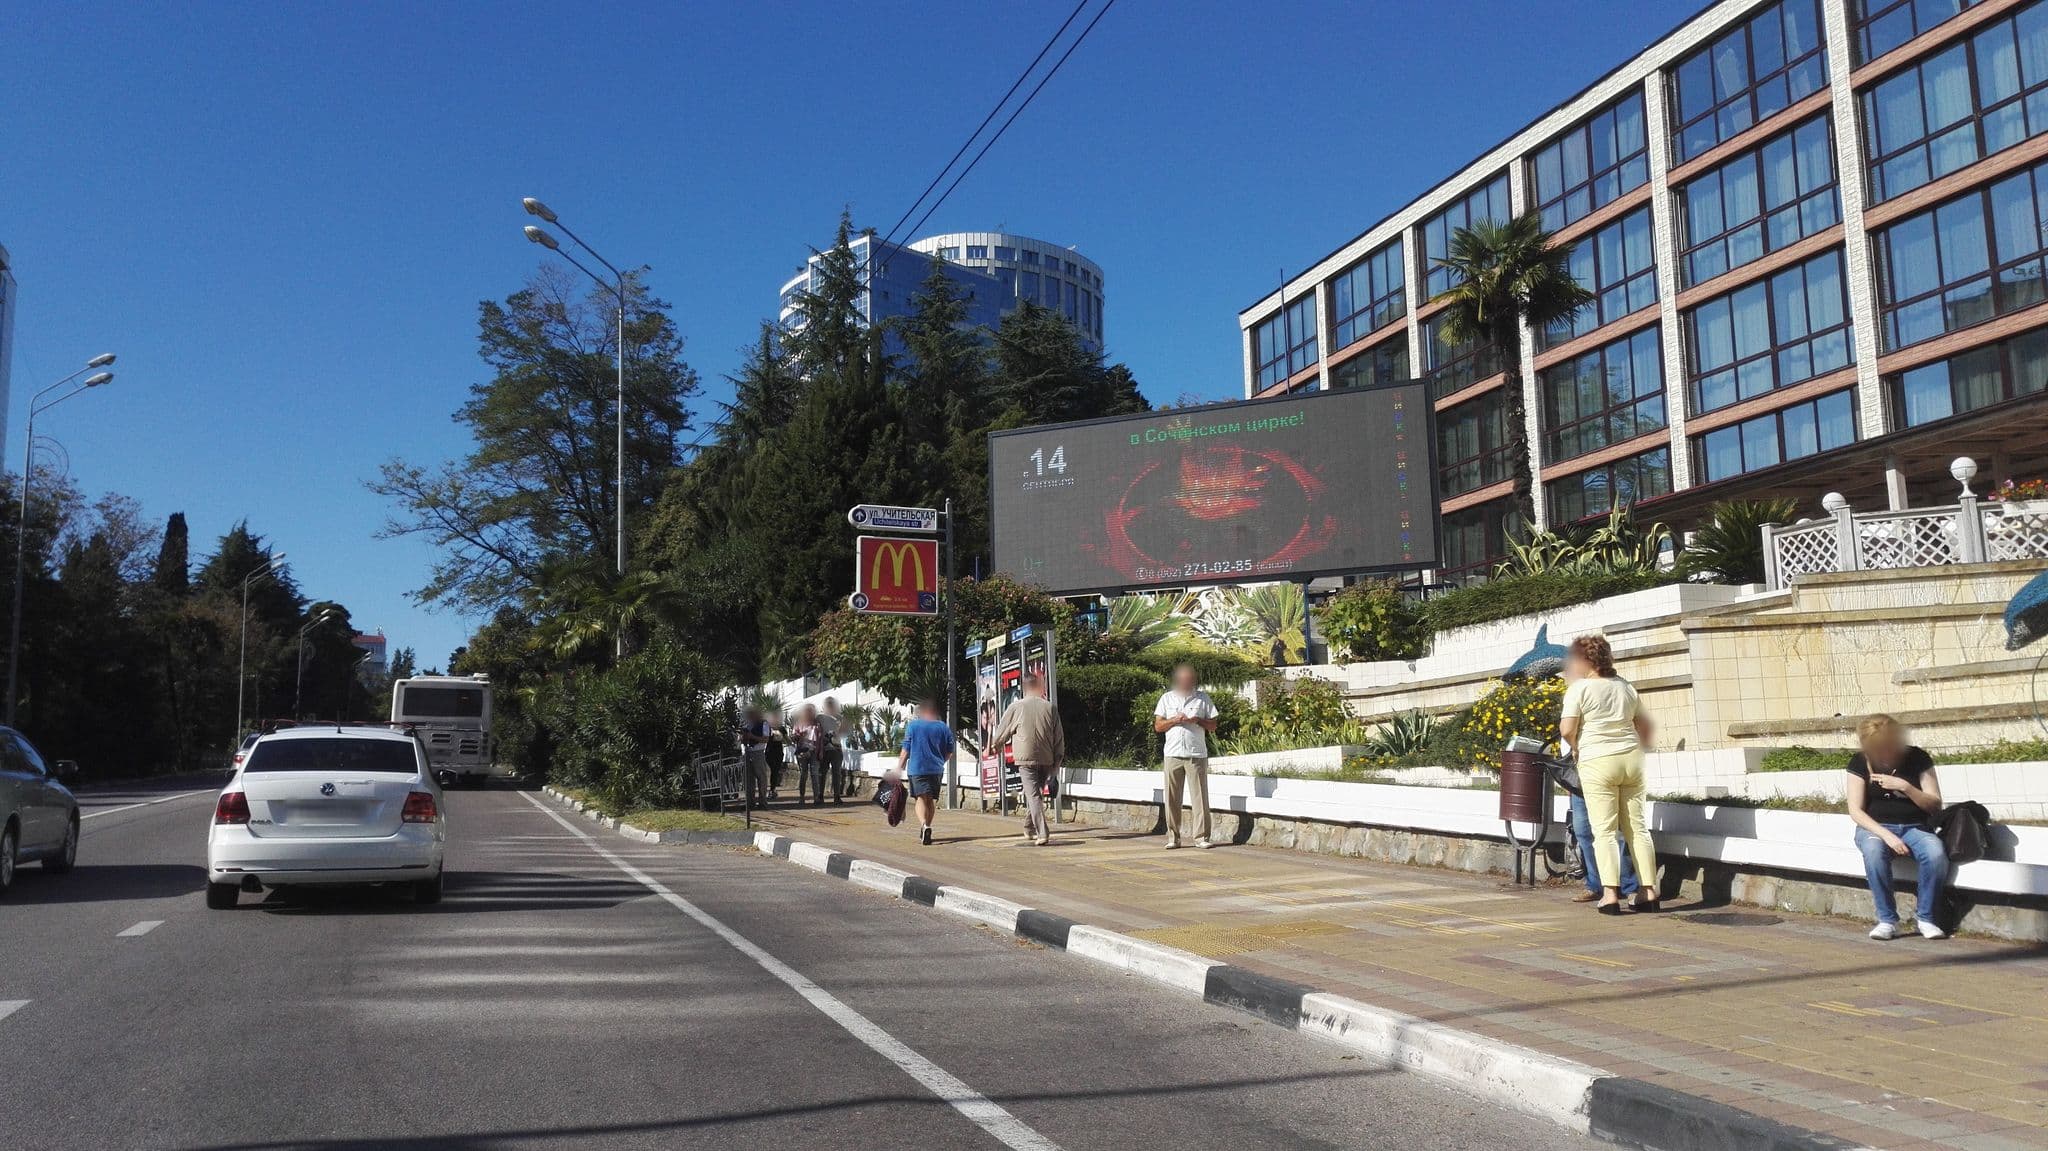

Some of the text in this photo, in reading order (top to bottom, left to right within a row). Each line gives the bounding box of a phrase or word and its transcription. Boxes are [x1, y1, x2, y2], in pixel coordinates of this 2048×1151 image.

[1130, 410, 1304, 445] в Сочинском цирке!
[1030, 446, 1067, 475] 14
[869, 508, 936, 521] ул. УЧИТЕЛЬСКАЯ
[1183, 559, 1253, 577] 271-02-85
